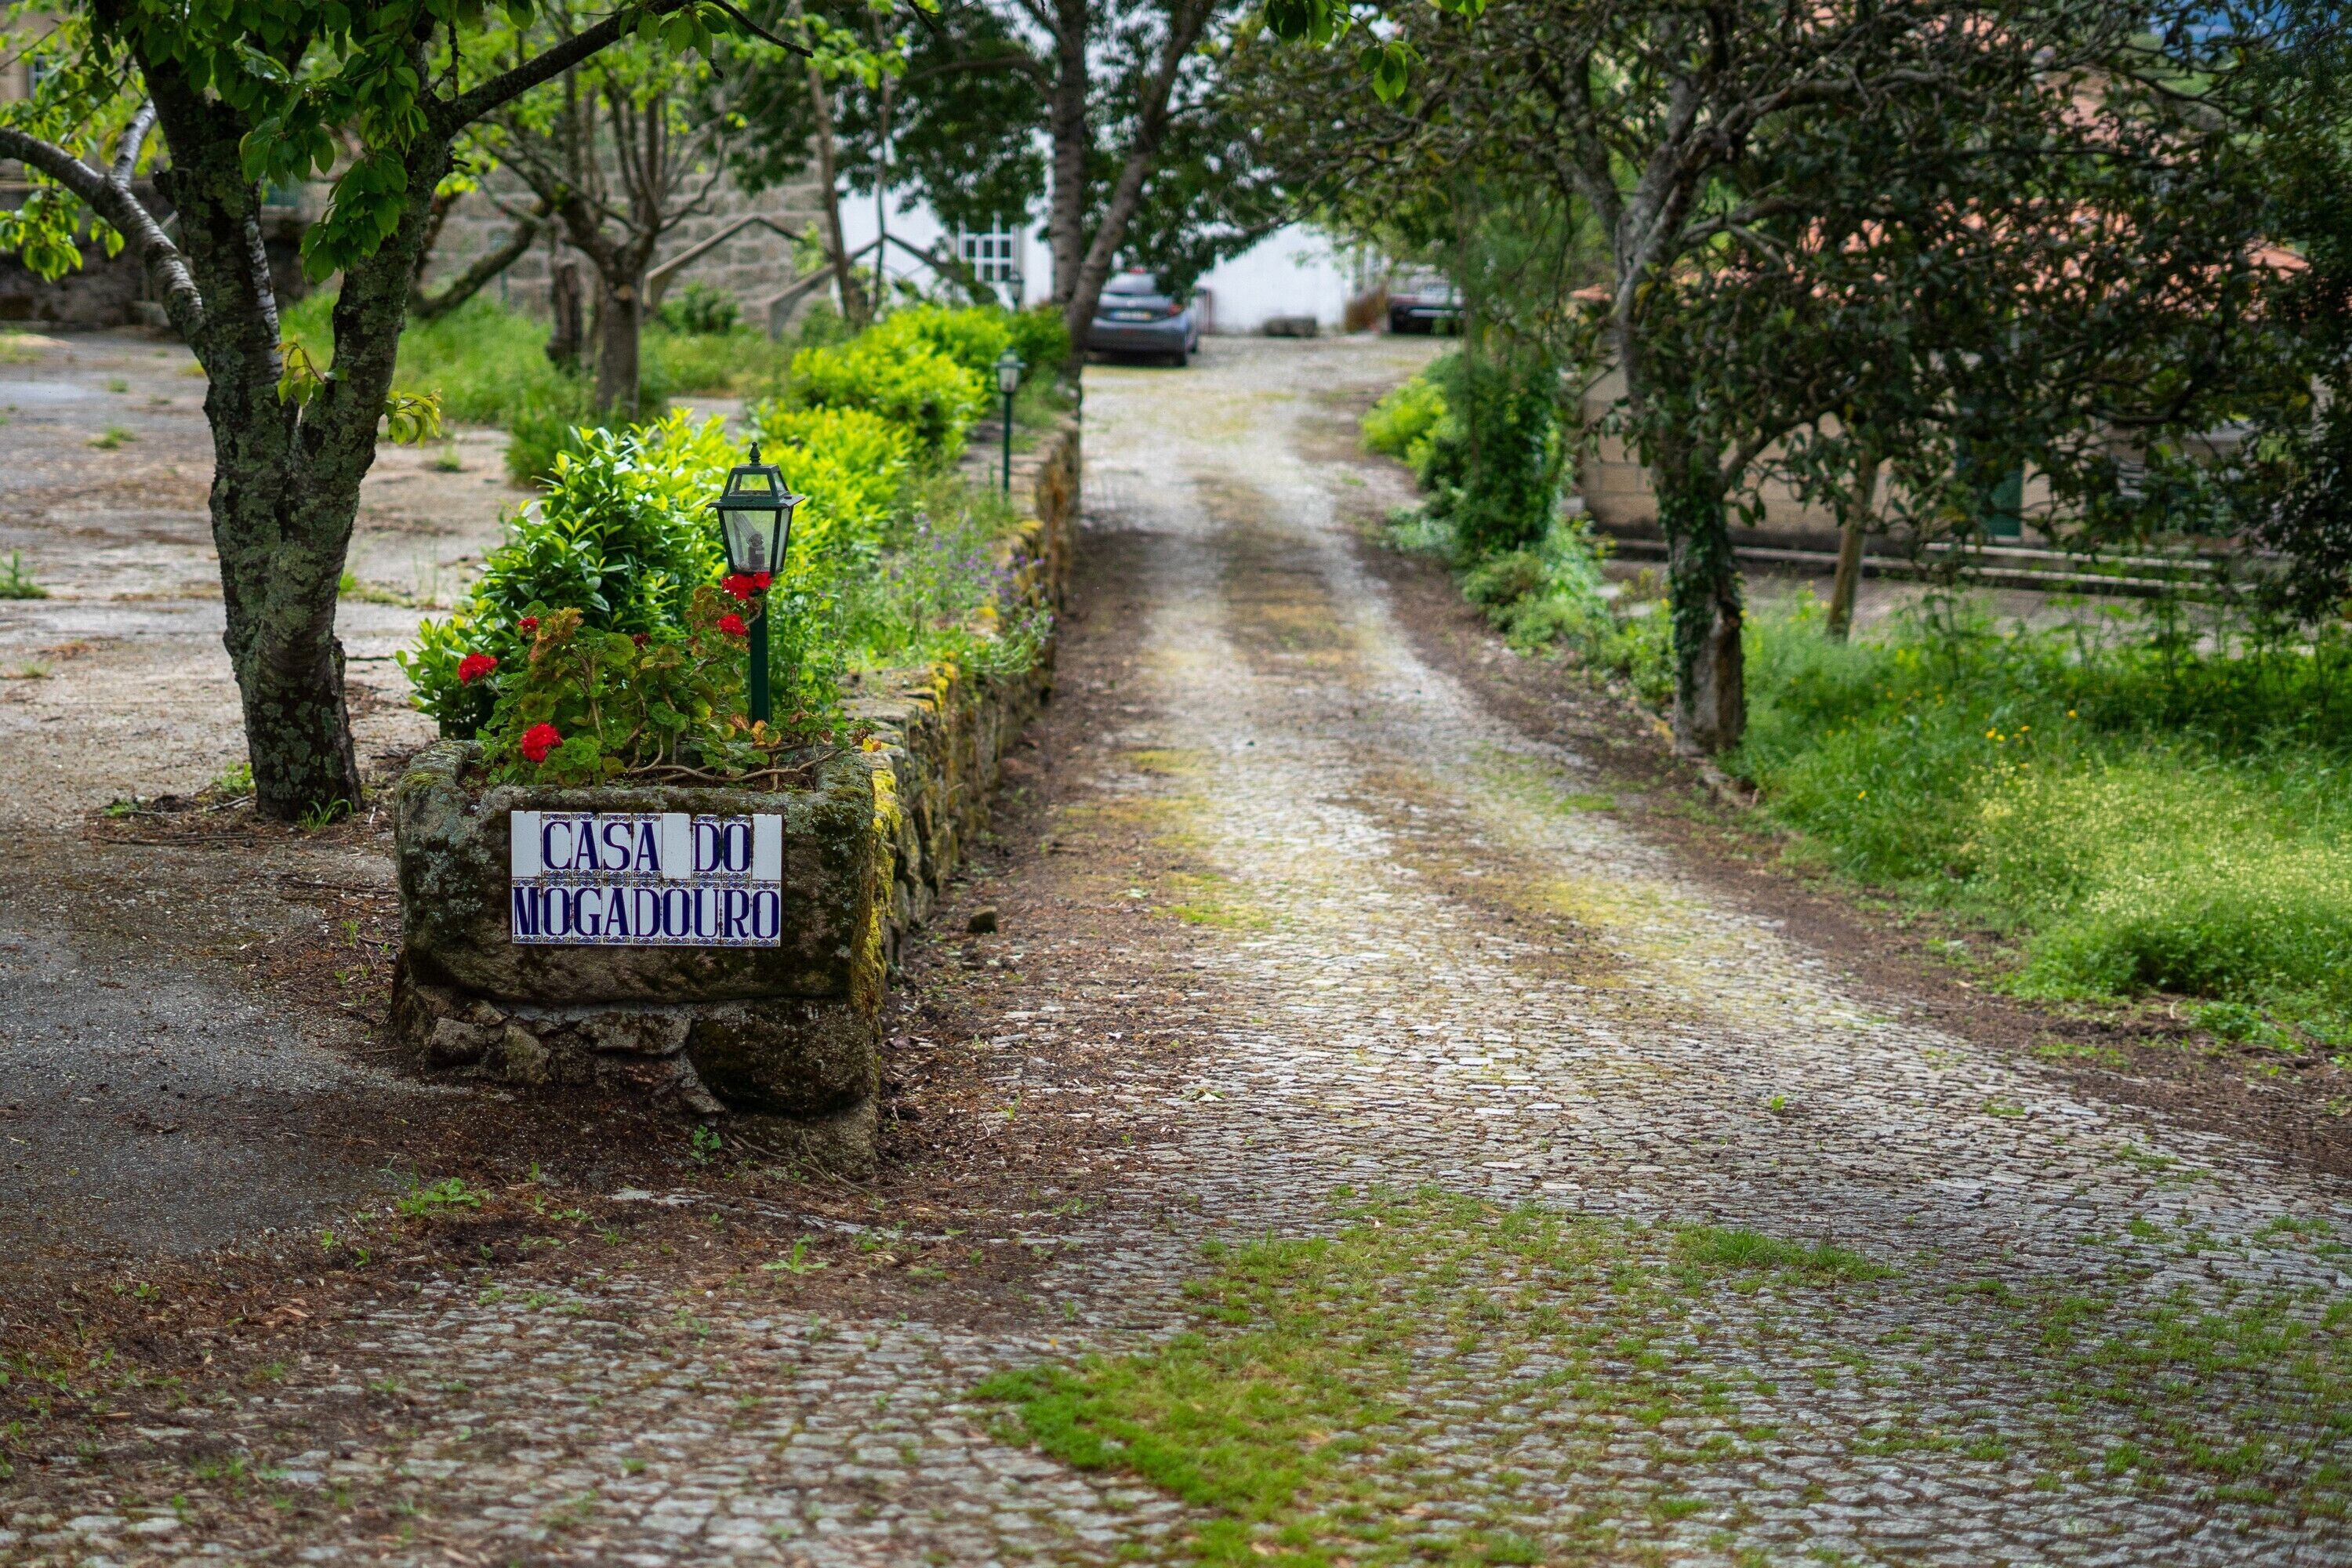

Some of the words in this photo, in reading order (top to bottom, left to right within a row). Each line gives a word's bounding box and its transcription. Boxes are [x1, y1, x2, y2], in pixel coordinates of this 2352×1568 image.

[543, 821, 661, 871] CASA
[693, 822, 751, 873] DO
[514, 886, 780, 939] MOGADOURO
